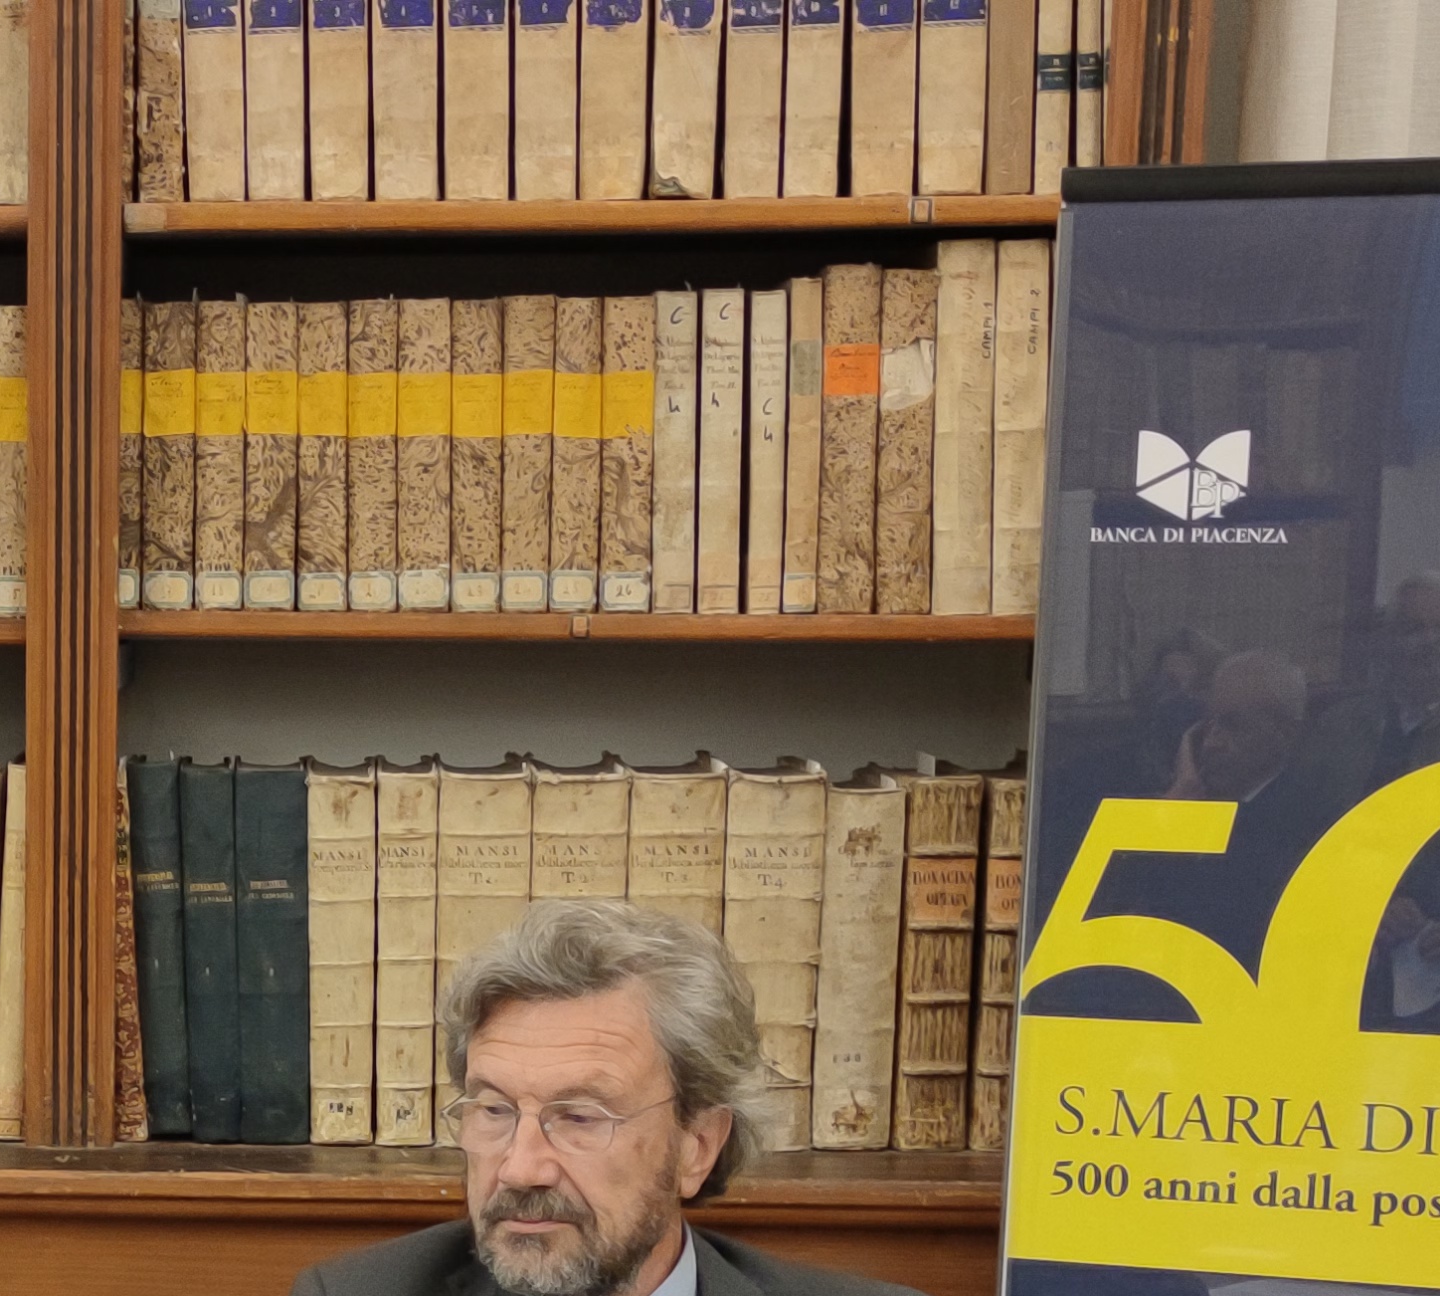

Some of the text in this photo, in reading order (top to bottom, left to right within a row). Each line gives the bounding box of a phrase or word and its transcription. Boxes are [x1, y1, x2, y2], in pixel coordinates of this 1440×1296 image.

[1090, 527, 1288, 545] BANCA DI PIACENZA
[456, 845, 520, 857] MANSI
[643, 844, 710, 856] MANSI
[744, 845, 813, 858] MANSI
[1050, 1160, 1129, 1198] 500
[1142, 1171, 1239, 1205] anni
[1252, 1170, 1359, 1213] dalla
